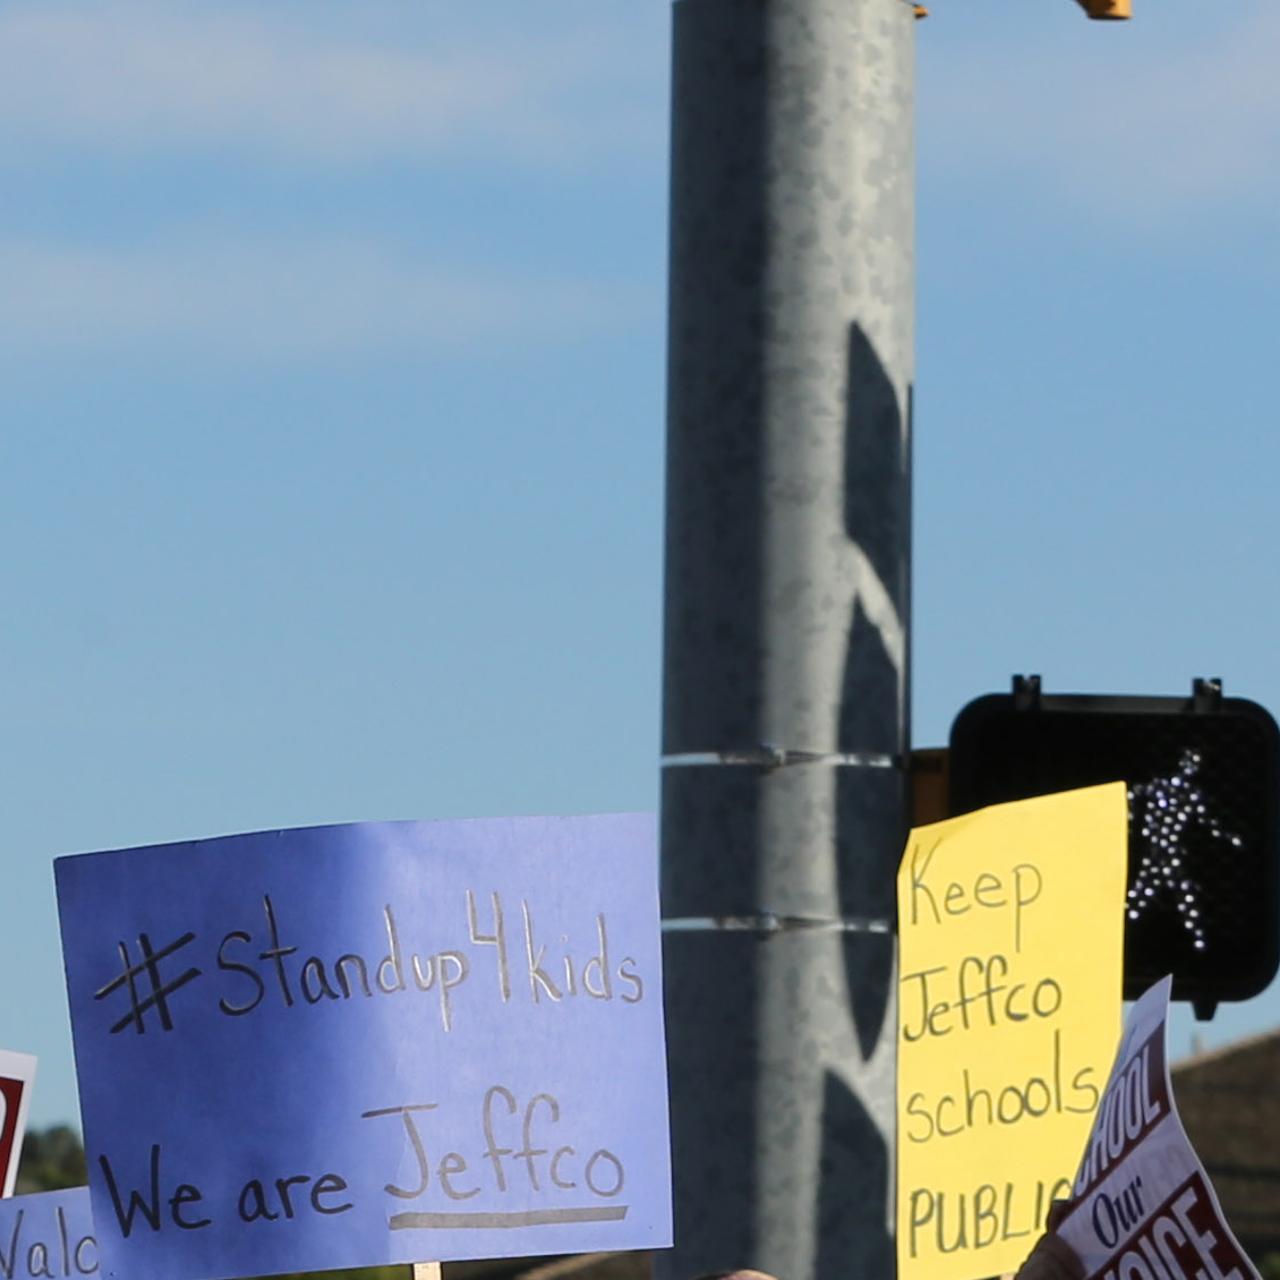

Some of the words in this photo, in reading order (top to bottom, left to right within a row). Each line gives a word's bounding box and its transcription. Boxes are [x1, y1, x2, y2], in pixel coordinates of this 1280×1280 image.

[909, 837, 1043, 953] Keep
[899, 954, 1062, 1044] Jeffco
[98, 1144, 212, 1239] We
[237, 1171, 354, 1222] are
[361, 1086, 625, 1201] Jeffco
[1091, 1175, 1143, 1249] Our
